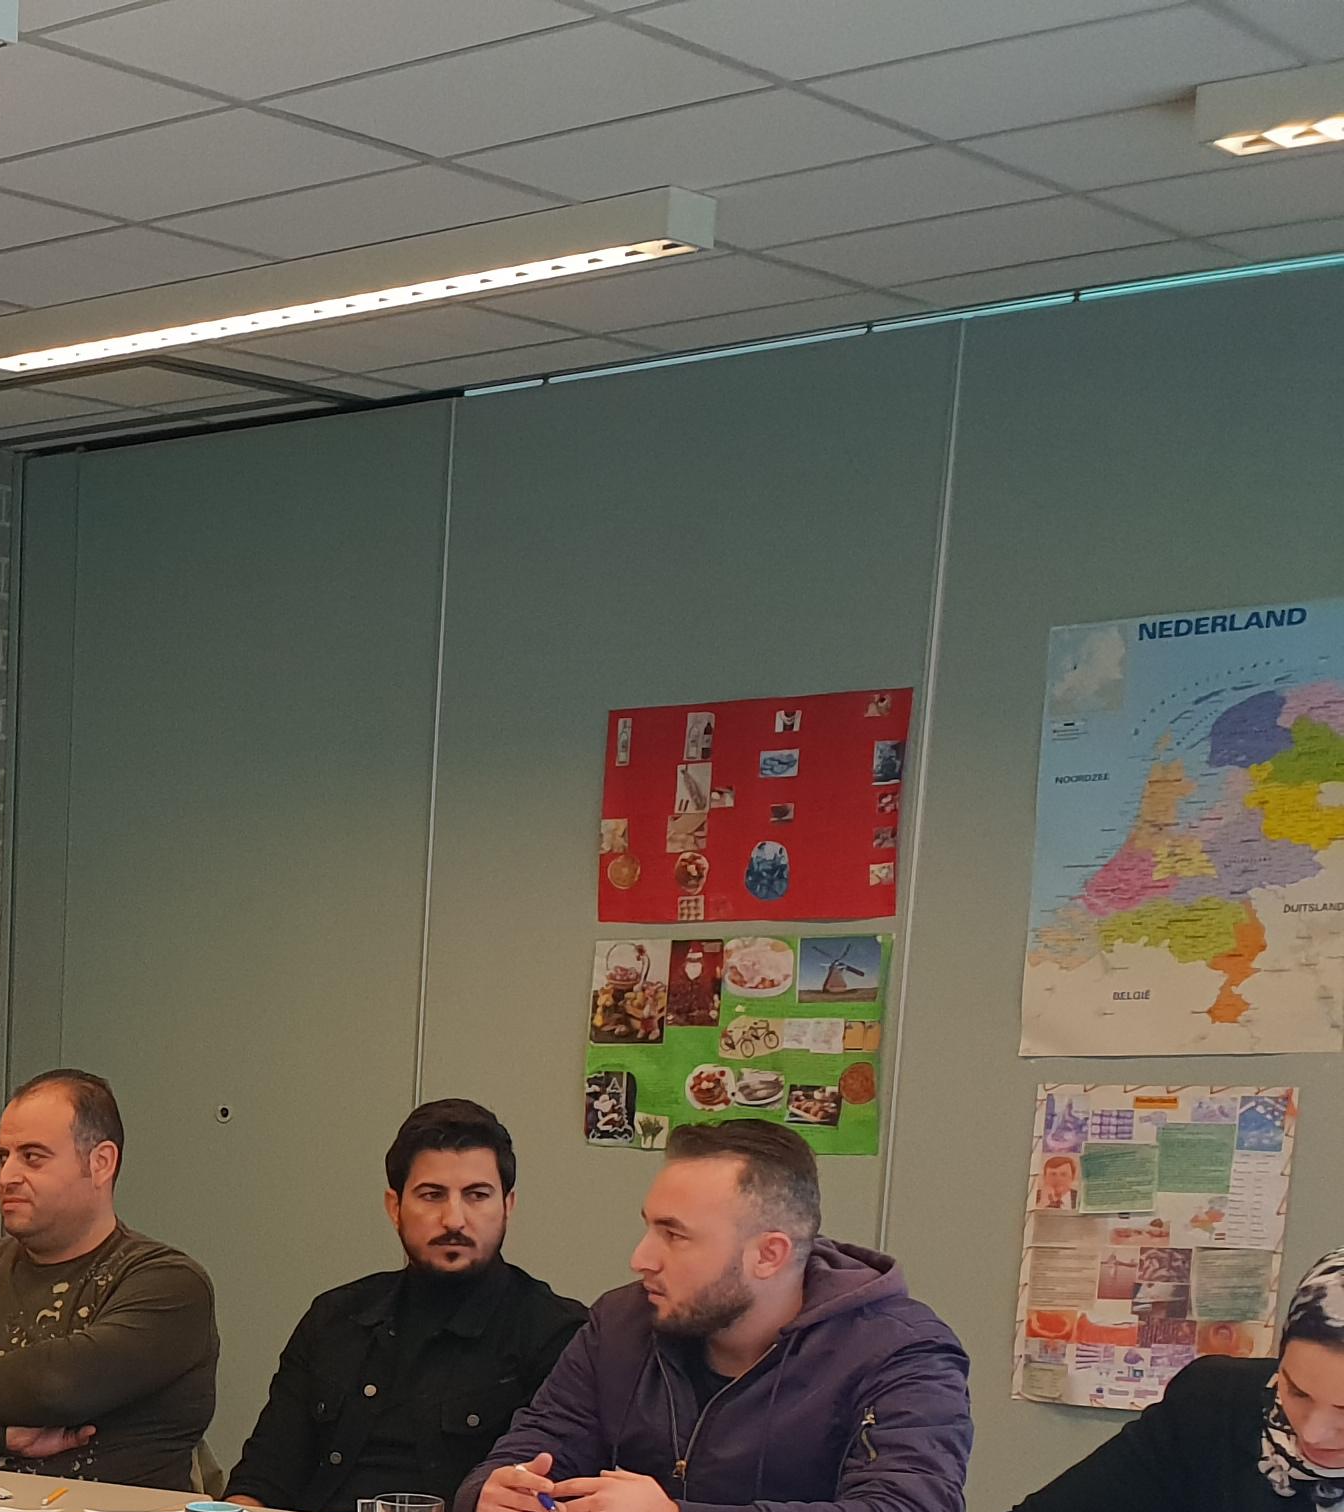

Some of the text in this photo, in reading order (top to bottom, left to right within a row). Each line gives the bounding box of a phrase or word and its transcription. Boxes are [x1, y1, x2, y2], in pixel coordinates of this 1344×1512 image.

[1138, 607, 1307, 641] NEDERLAND
[1055, 772, 1110, 785] NOORDZEE
[1283, 902, 1344, 914] DUITSLAND
